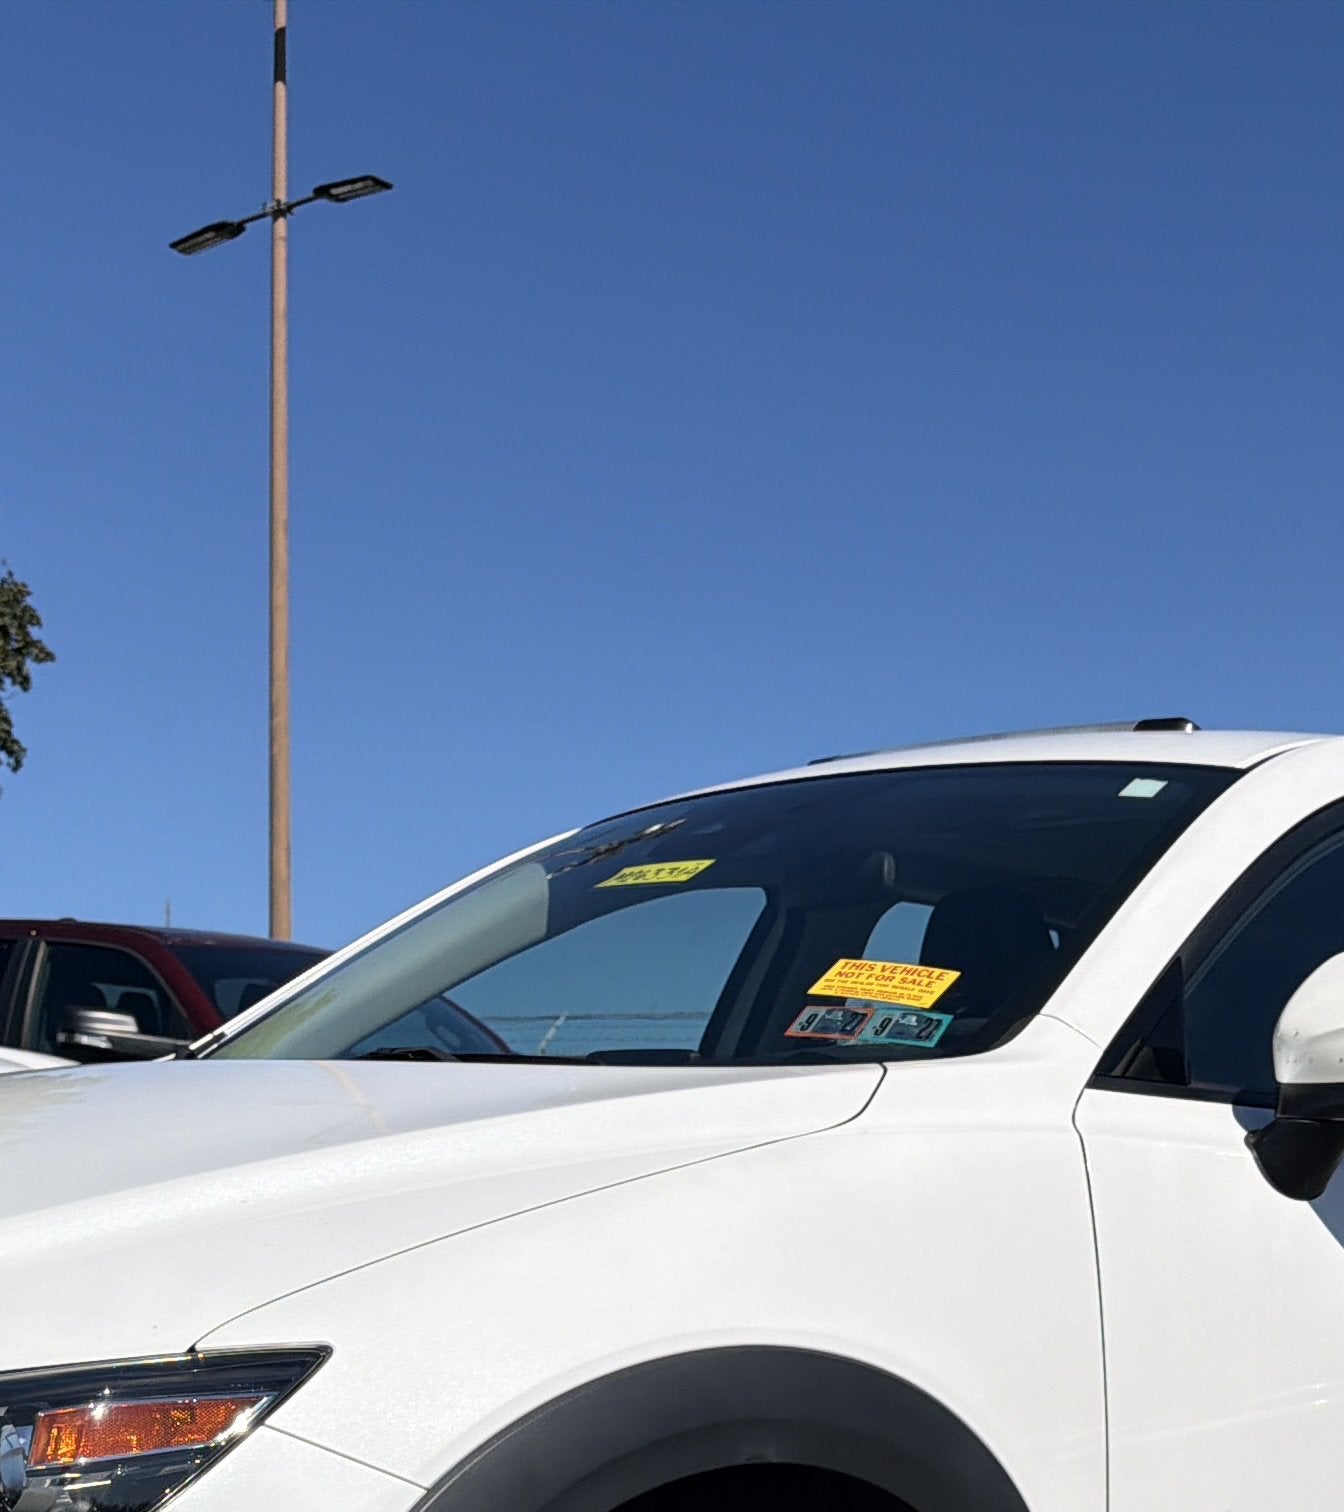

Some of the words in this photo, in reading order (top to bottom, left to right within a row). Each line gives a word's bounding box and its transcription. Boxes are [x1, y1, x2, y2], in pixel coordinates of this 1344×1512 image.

[834, 971, 864, 980] NOT
[867, 973, 894, 982] FOR
[899, 976, 938, 988] SALE
[841, 961, 878, 972] THIS
[881, 964, 950, 981] VEHICLE
